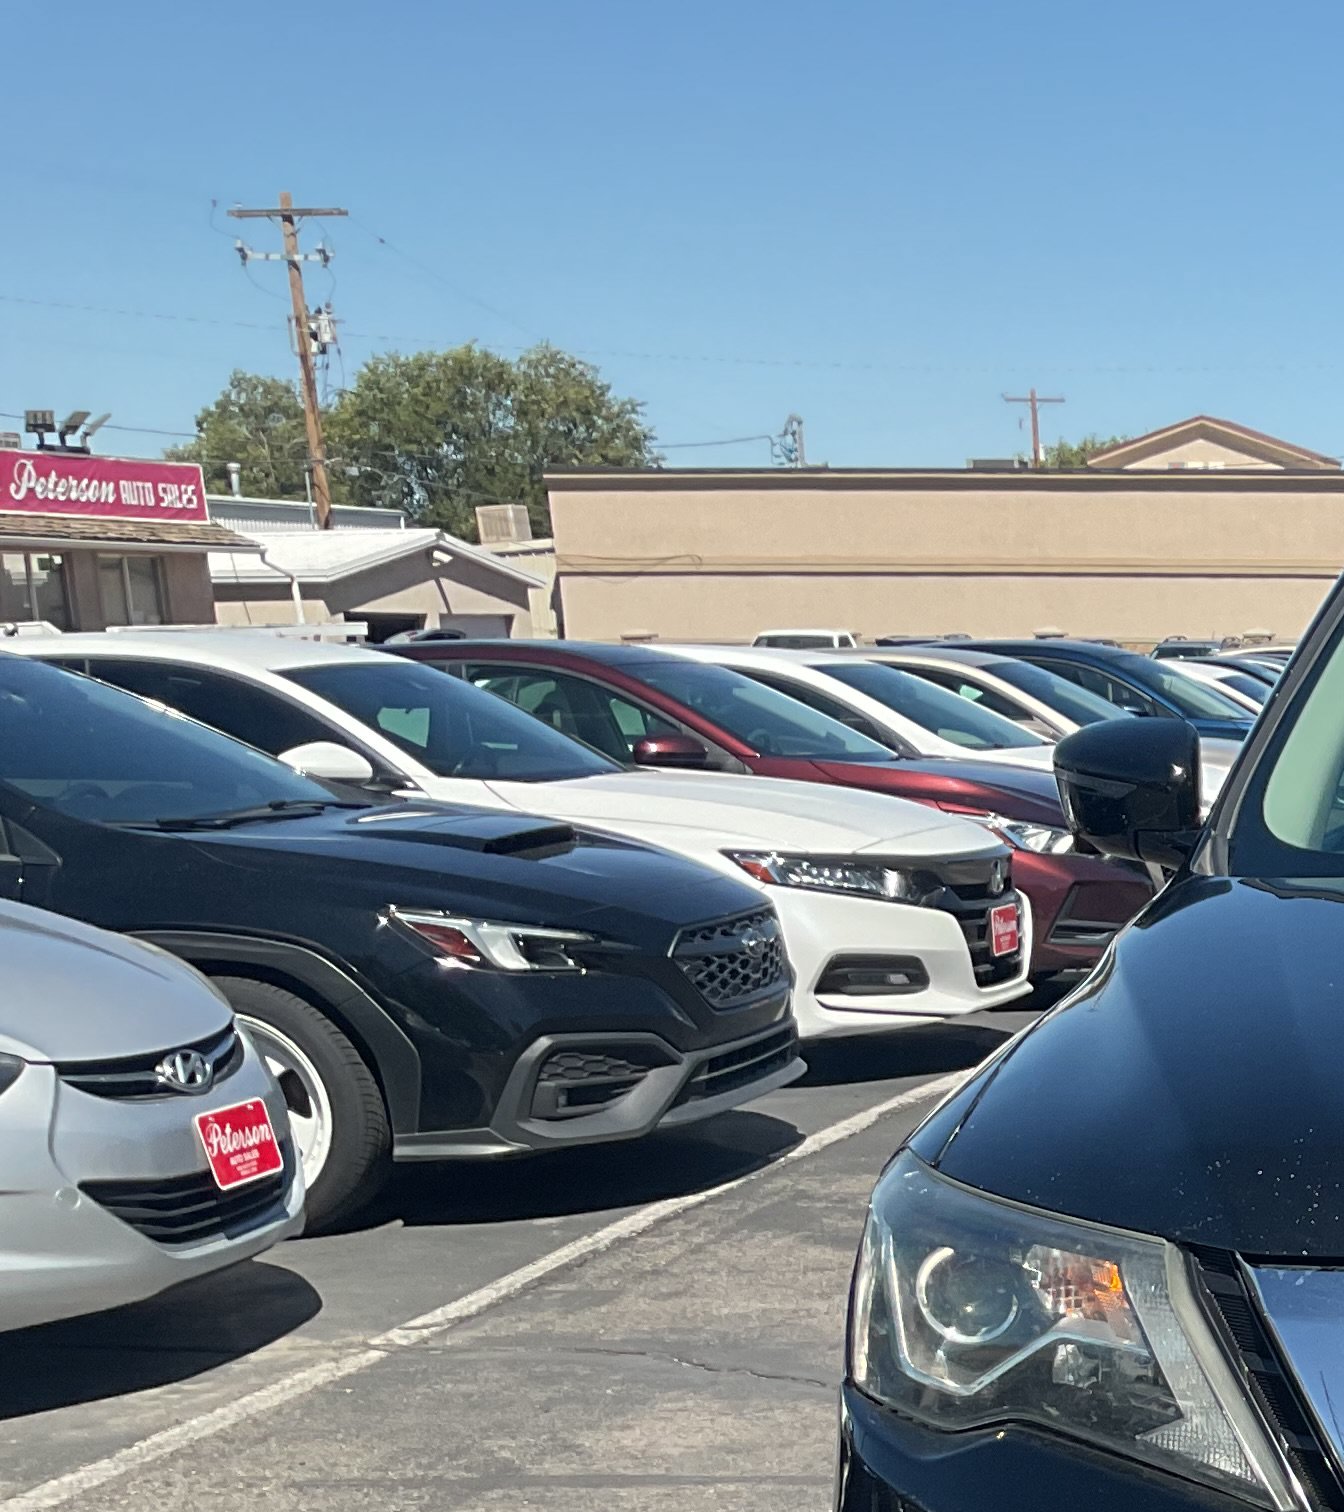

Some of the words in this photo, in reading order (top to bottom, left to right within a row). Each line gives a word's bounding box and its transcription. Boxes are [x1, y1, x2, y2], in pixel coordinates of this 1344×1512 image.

[10, 458, 116, 504] Peterson
[119, 480, 155, 506] AUTO
[158, 483, 198, 509] SALES
[205, 1122, 271, 1158] Peterson
